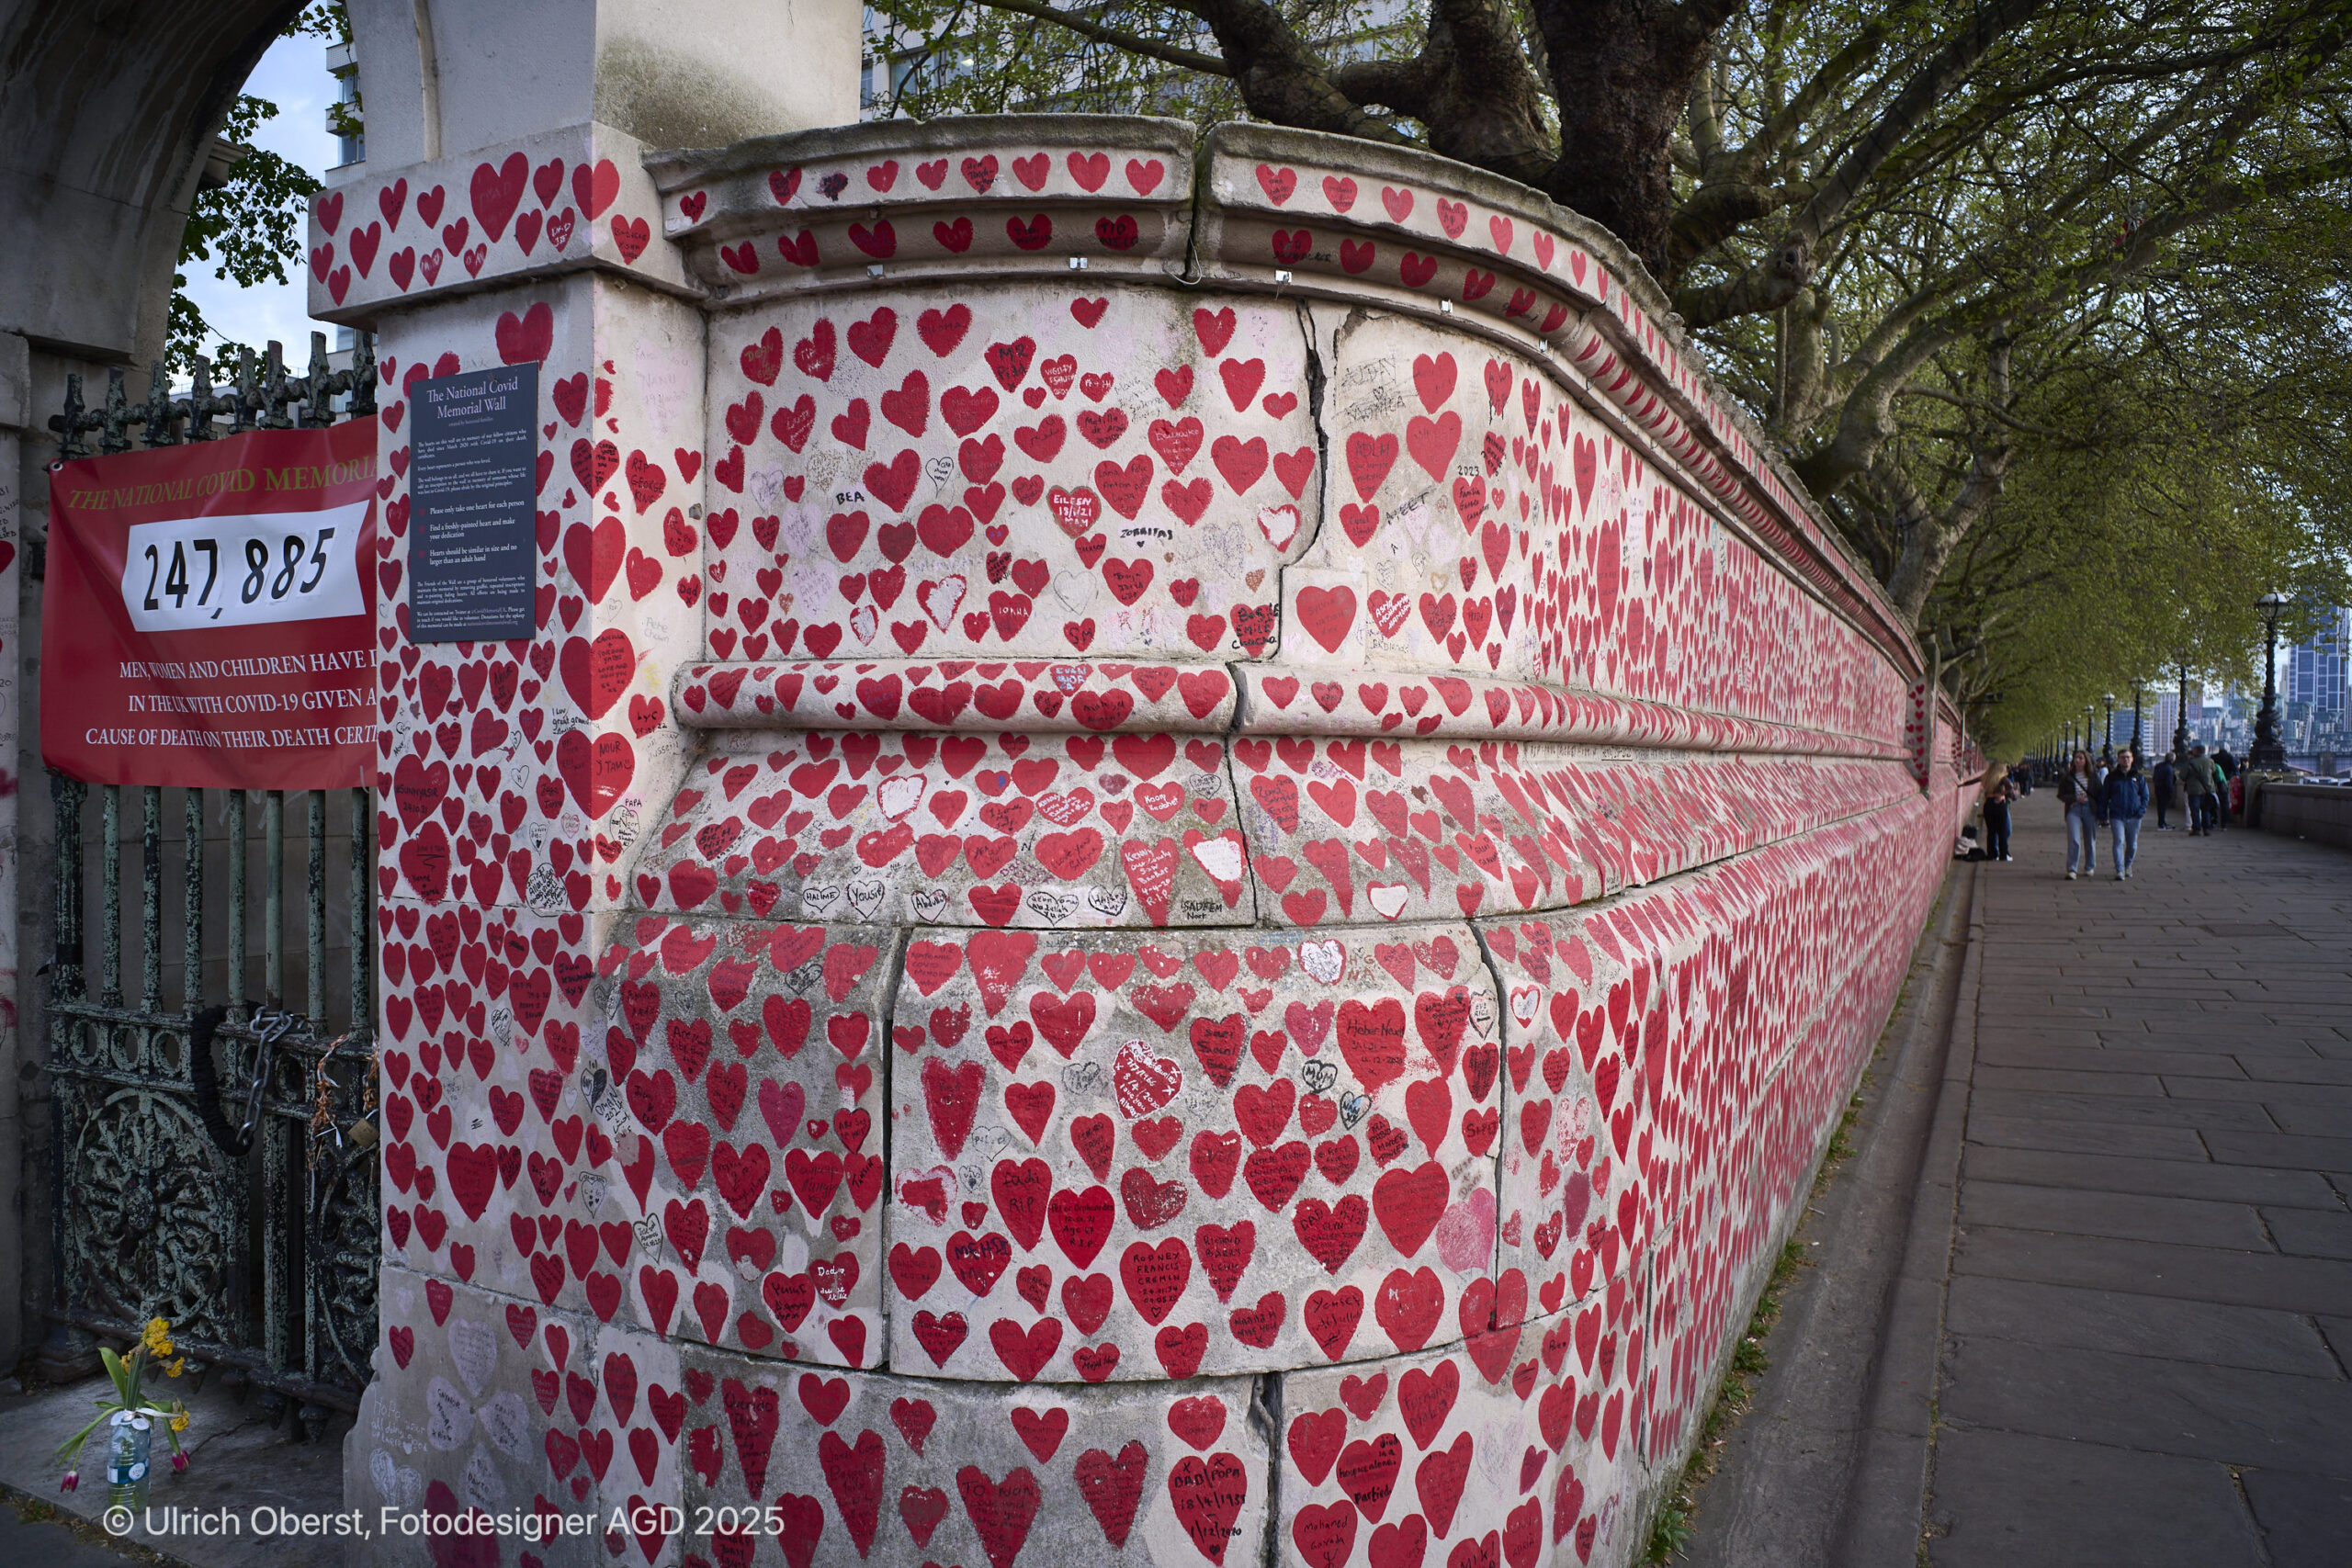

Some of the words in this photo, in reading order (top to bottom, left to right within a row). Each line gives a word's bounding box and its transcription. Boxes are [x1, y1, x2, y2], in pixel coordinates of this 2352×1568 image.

[426, 389, 444, 402] The
[446, 380, 486, 400] National
[489, 376, 518, 394] Covid
[437, 400, 481, 420] Memorial
[484, 396, 506, 412] Wall
[1458, 465, 1480, 477] 2023
[67, 489, 109, 511] THE
[111, 478, 193, 506] NATIONAL
[196, 468, 255, 496] COVID
[836, 491, 865, 505] BEA
[1054, 494, 1091, 505] EILEEN
[430, 507, 444, 515] Please
[445, 505, 454, 514] only
[456, 504, 465, 513] take
[475, 502, 488, 511] heart
[508, 501, 525, 510] person
[480, 519, 492, 527] heart
[492, 517, 502, 525] and
[429, 534, 440, 542] your
[441, 531, 464, 539] dedication
[446, 547, 460, 555] should
[469, 545, 484, 553] similar
[429, 558, 442, 567] larger
[461, 555, 473, 563] adult
[119, 661, 151, 682] MEN,
[151, 661, 186, 680] WOMEN
[188, 660, 220, 679] AND
[220, 655, 306, 677] CHILDREN
[311, 650, 365, 672] HAVE
[129, 695, 147, 712] IN
[148, 694, 173, 713] THE
[172, 695, 188, 714] UK
[186, 694, 224, 714] WITH
[225, 693, 299, 714] COVID-19
[302, 688, 362, 711] GIVEN
[85, 728, 136, 746] CAUSE
[139, 728, 158, 746] OF
[161, 728, 203, 747] DEATH
[202, 730, 221, 749] ON
[221, 731, 268, 749] THEIR
[271, 728, 332, 749] DEATH
[626, 798, 642, 807] PAPA
[807, 891, 838, 901] HALIME
[1301, 1208, 1324, 1230] DAD
[1062, 1226, 1080, 1235] Age
[1133, 1251, 1180, 1263] RODNEY
[1136, 1262, 1179, 1274] FRANCIS
[1137, 1274, 1180, 1285] CREMIN
[1380, 1433, 1399, 1449] died
